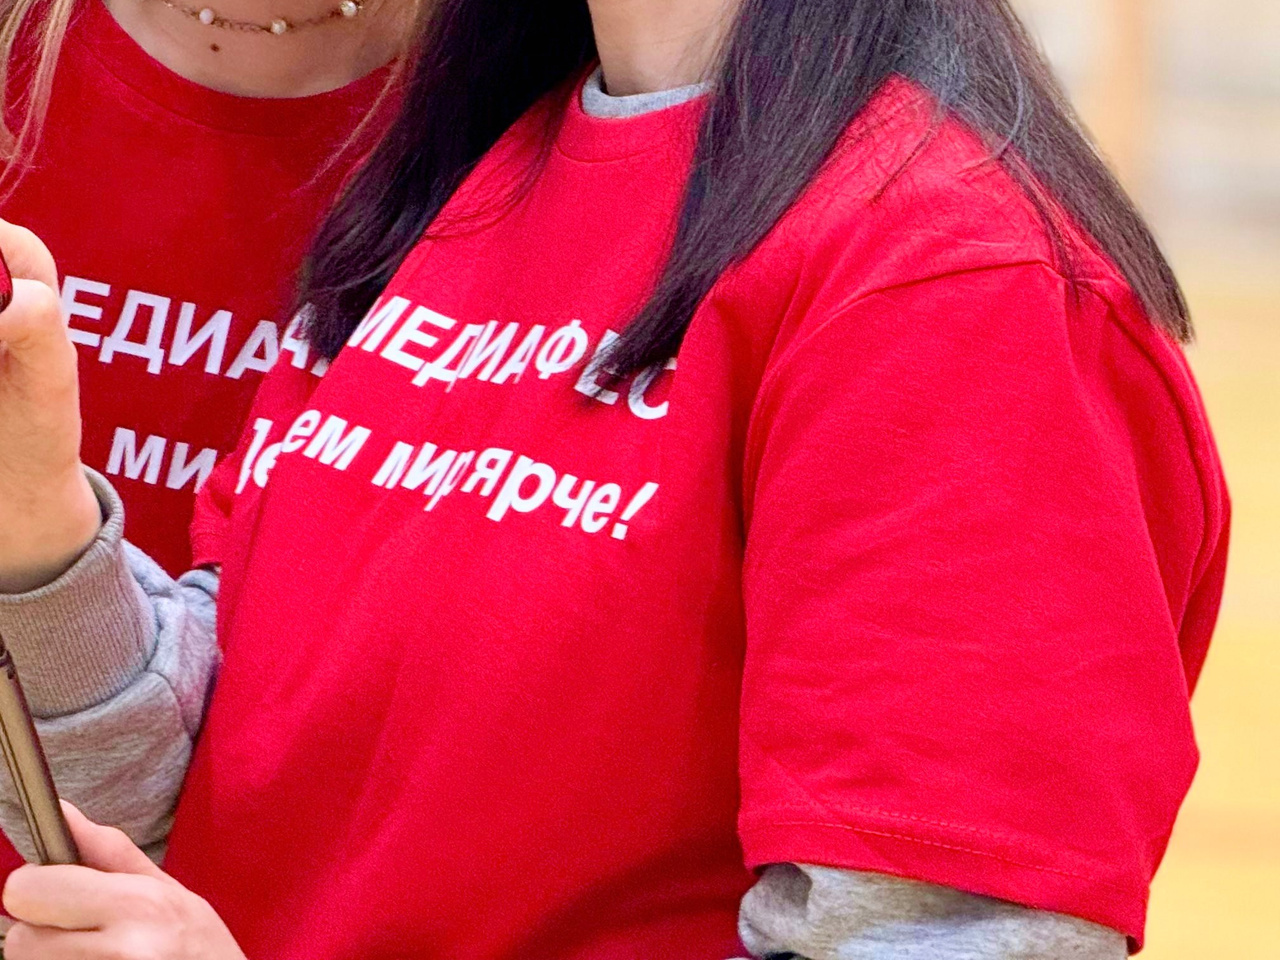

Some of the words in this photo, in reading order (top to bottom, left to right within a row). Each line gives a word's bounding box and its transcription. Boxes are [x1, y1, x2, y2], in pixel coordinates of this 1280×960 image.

[60, 275, 279, 380] ЕДИА
[106, 426, 218, 495] ми
[460, 447, 660, 541] ярче!
